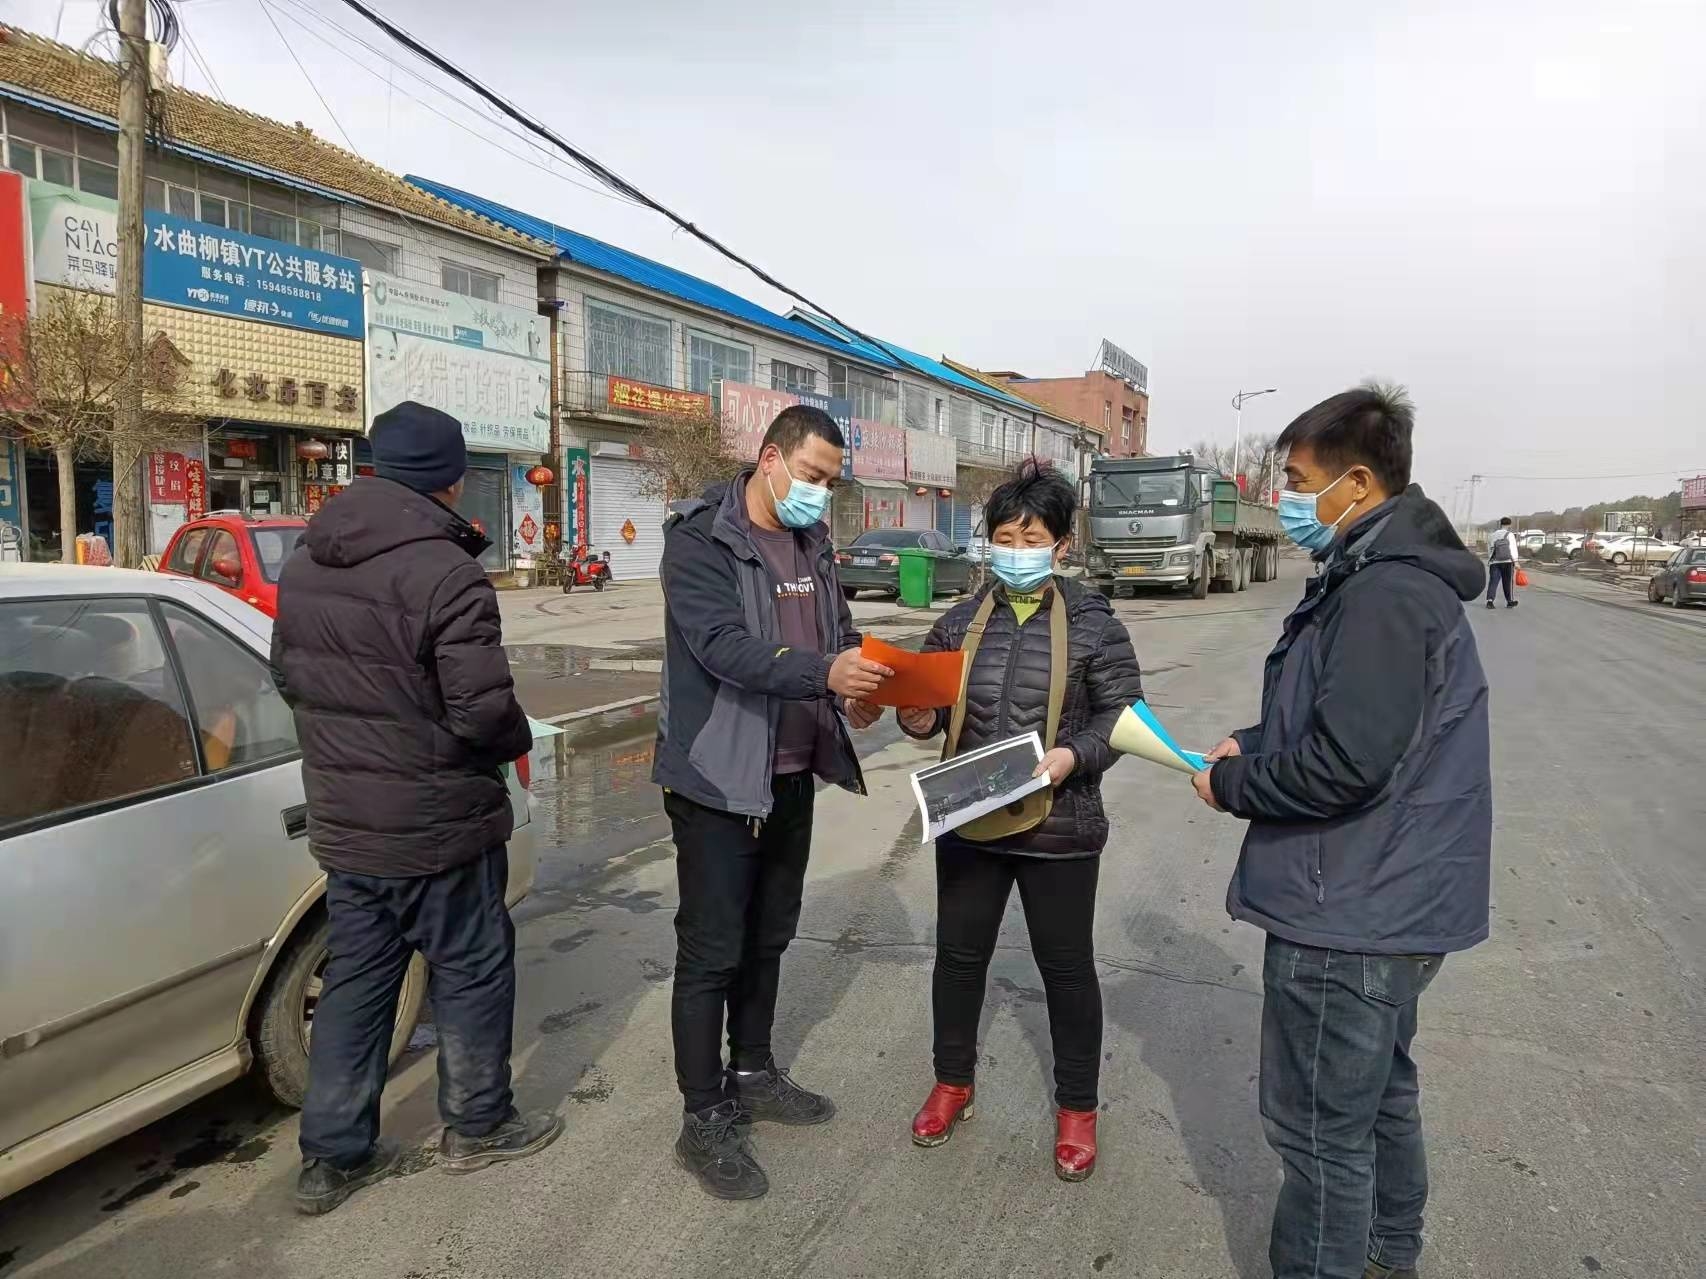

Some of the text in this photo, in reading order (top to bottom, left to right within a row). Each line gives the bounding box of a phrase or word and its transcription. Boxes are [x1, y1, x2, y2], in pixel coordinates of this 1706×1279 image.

[64, 216, 99, 237] CAI
[153, 224, 356, 294] 水曲柳镇YT公共服务站
[727, 389, 793, 433] 可心文具
